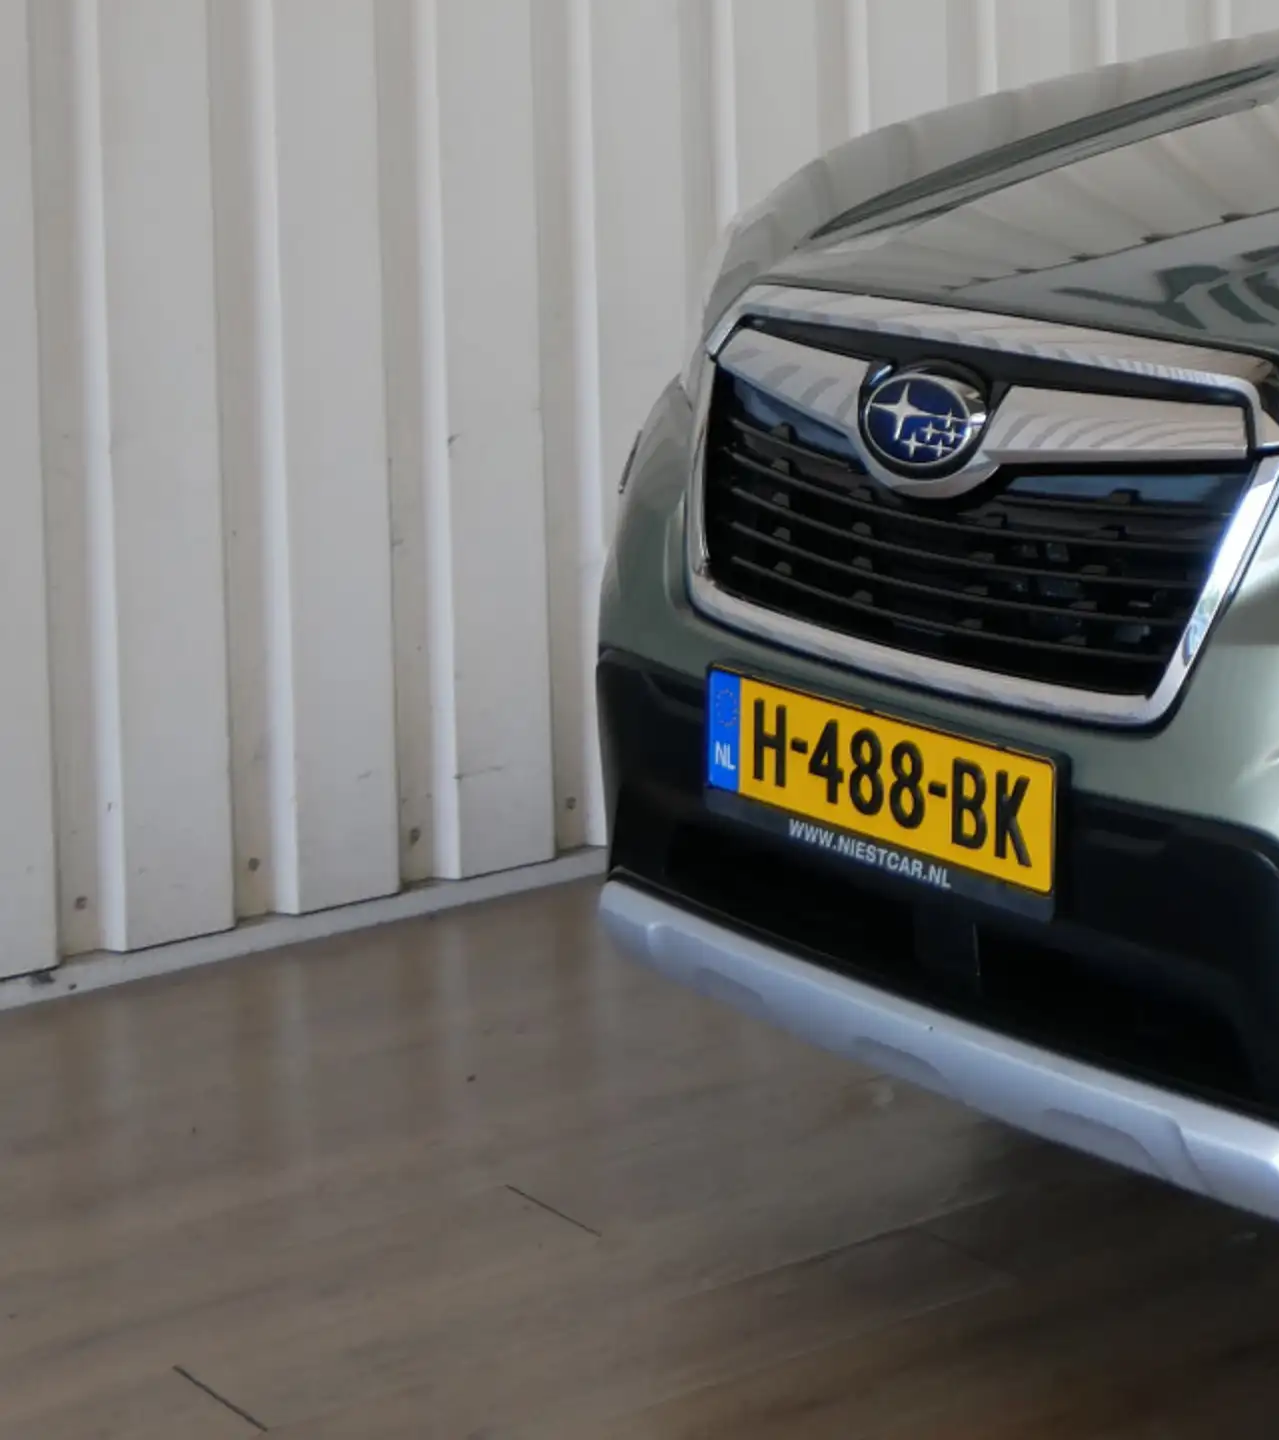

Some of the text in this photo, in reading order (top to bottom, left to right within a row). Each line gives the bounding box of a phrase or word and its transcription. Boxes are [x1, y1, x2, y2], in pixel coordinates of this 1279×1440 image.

[714, 740, 736, 771] NL
[752, 697, 1032, 868] H-488-BK
[788, 818, 952, 889] WWW.NIESTCAR.NL
